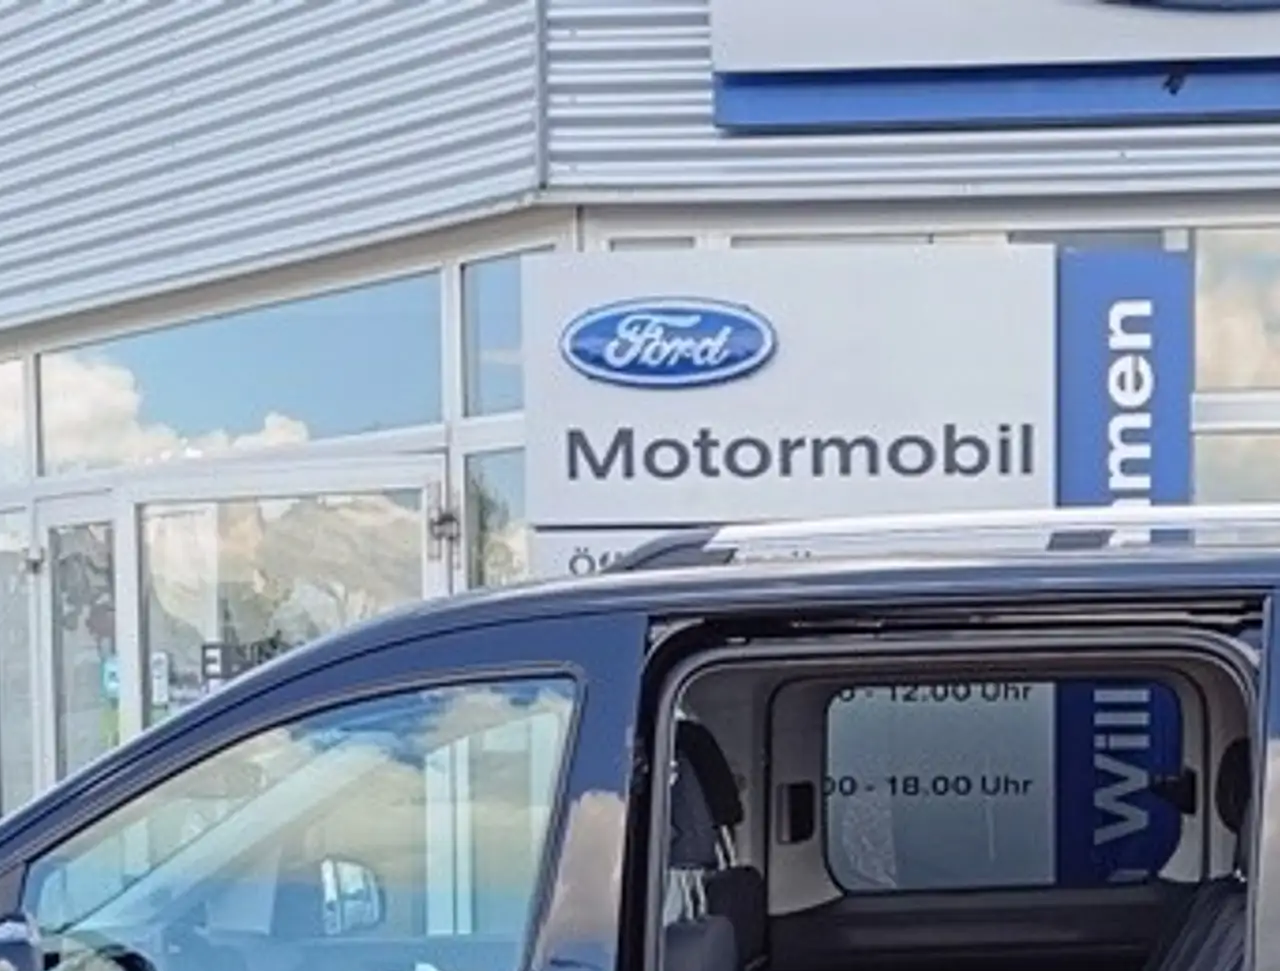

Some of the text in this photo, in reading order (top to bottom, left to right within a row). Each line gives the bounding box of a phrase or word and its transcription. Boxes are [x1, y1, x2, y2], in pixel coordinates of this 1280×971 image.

[604, 315, 733, 368] Ford
[567, 423, 1034, 480] Motormobil
[888, 683, 972, 703] 12.00
[980, 682, 1033, 702] Uhr
[886, 775, 973, 797] 18.00
[980, 773, 1034, 797] Uhr
[1093, 688, 1151, 846] Will
